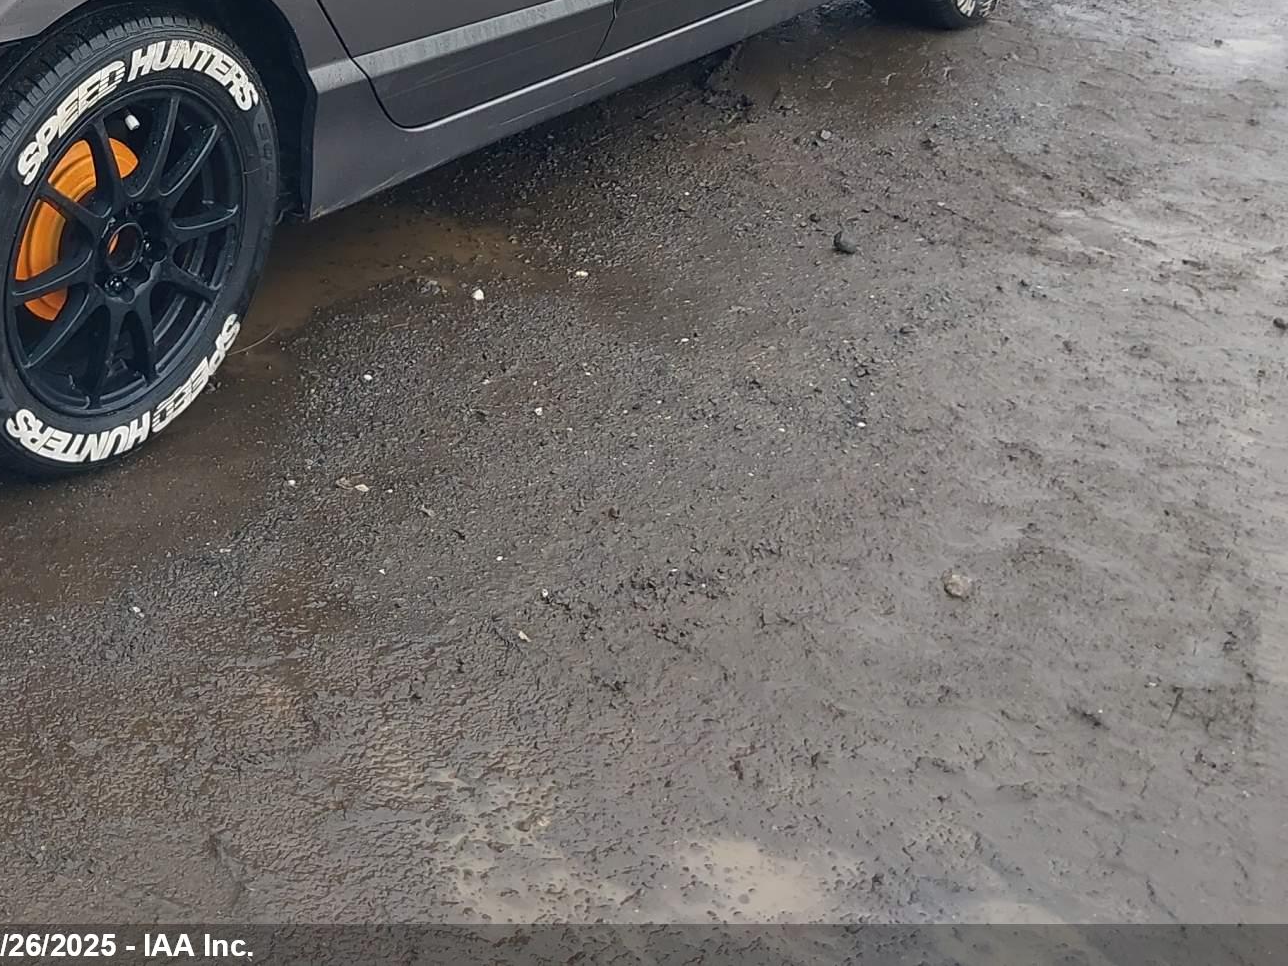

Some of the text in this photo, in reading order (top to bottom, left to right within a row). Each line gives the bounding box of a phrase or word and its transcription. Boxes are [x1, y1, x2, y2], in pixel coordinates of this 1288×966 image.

[16, 38, 259, 186] SPEED HUNTERS
[5, 312, 242, 463] SPEED HUNTERS
